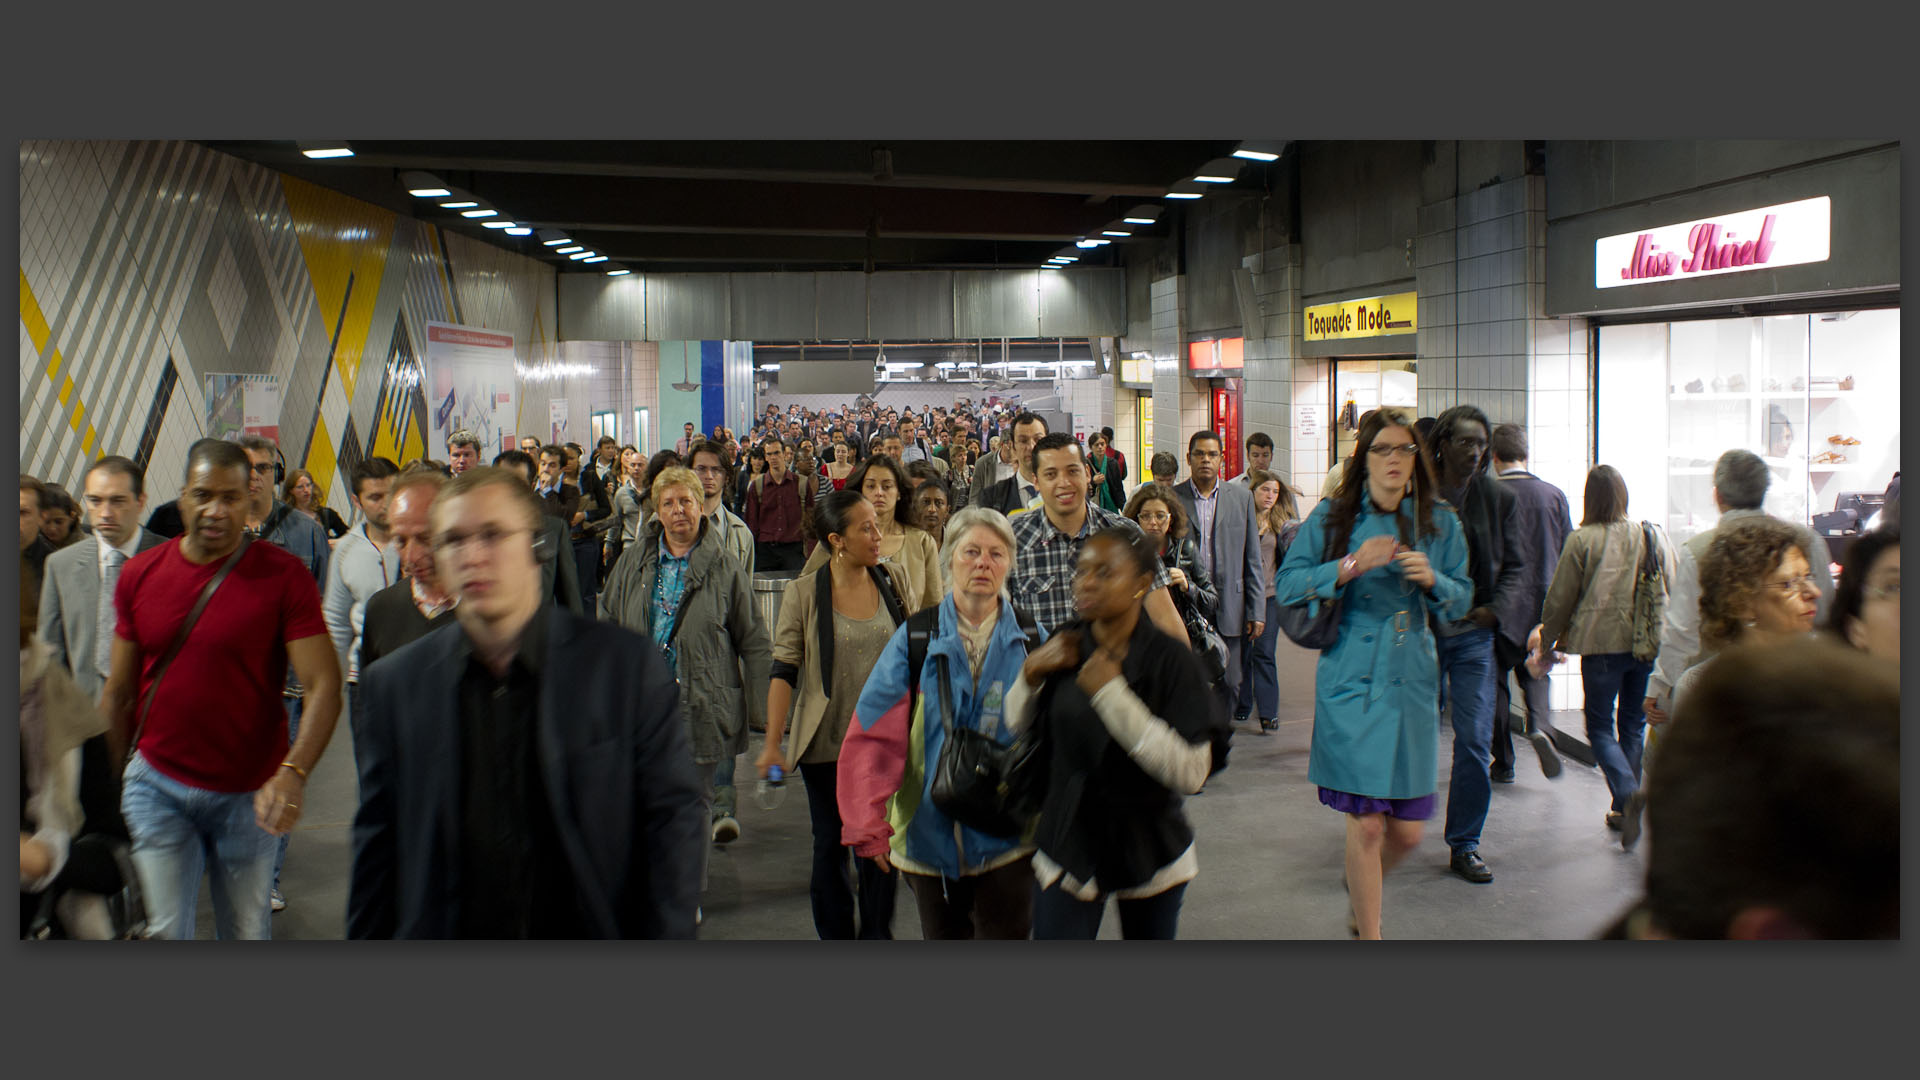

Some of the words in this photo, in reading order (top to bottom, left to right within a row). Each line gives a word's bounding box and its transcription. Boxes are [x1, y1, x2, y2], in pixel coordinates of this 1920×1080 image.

[1621, 234, 1679, 280] Miss
[1308, 308, 1351, 339] Toquade
[1357, 303, 1391, 330] Mode
